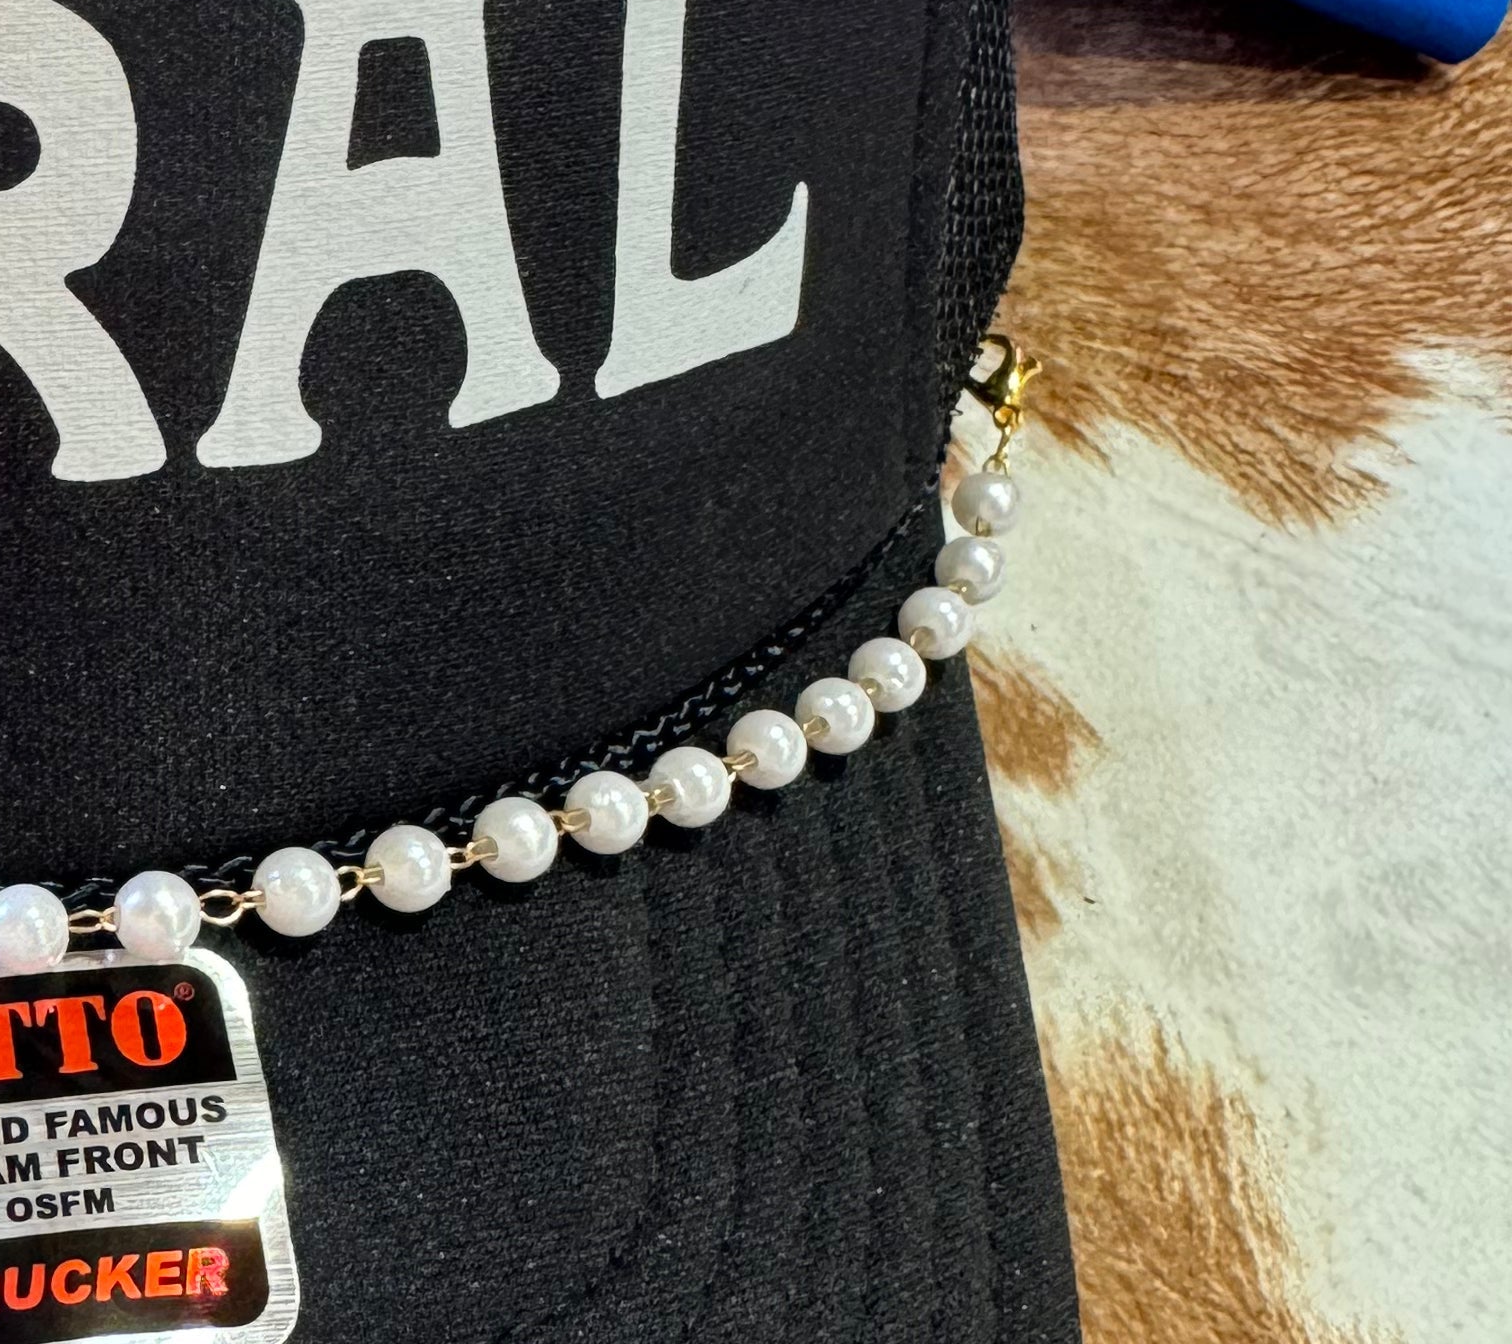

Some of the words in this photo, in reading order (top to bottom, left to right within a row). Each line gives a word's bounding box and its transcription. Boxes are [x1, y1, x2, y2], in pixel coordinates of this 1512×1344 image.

[46, 1095, 228, 1139] FAMOUS
[58, 1136, 205, 1178] FRONT
[6, 1188, 116, 1222] OSFM
